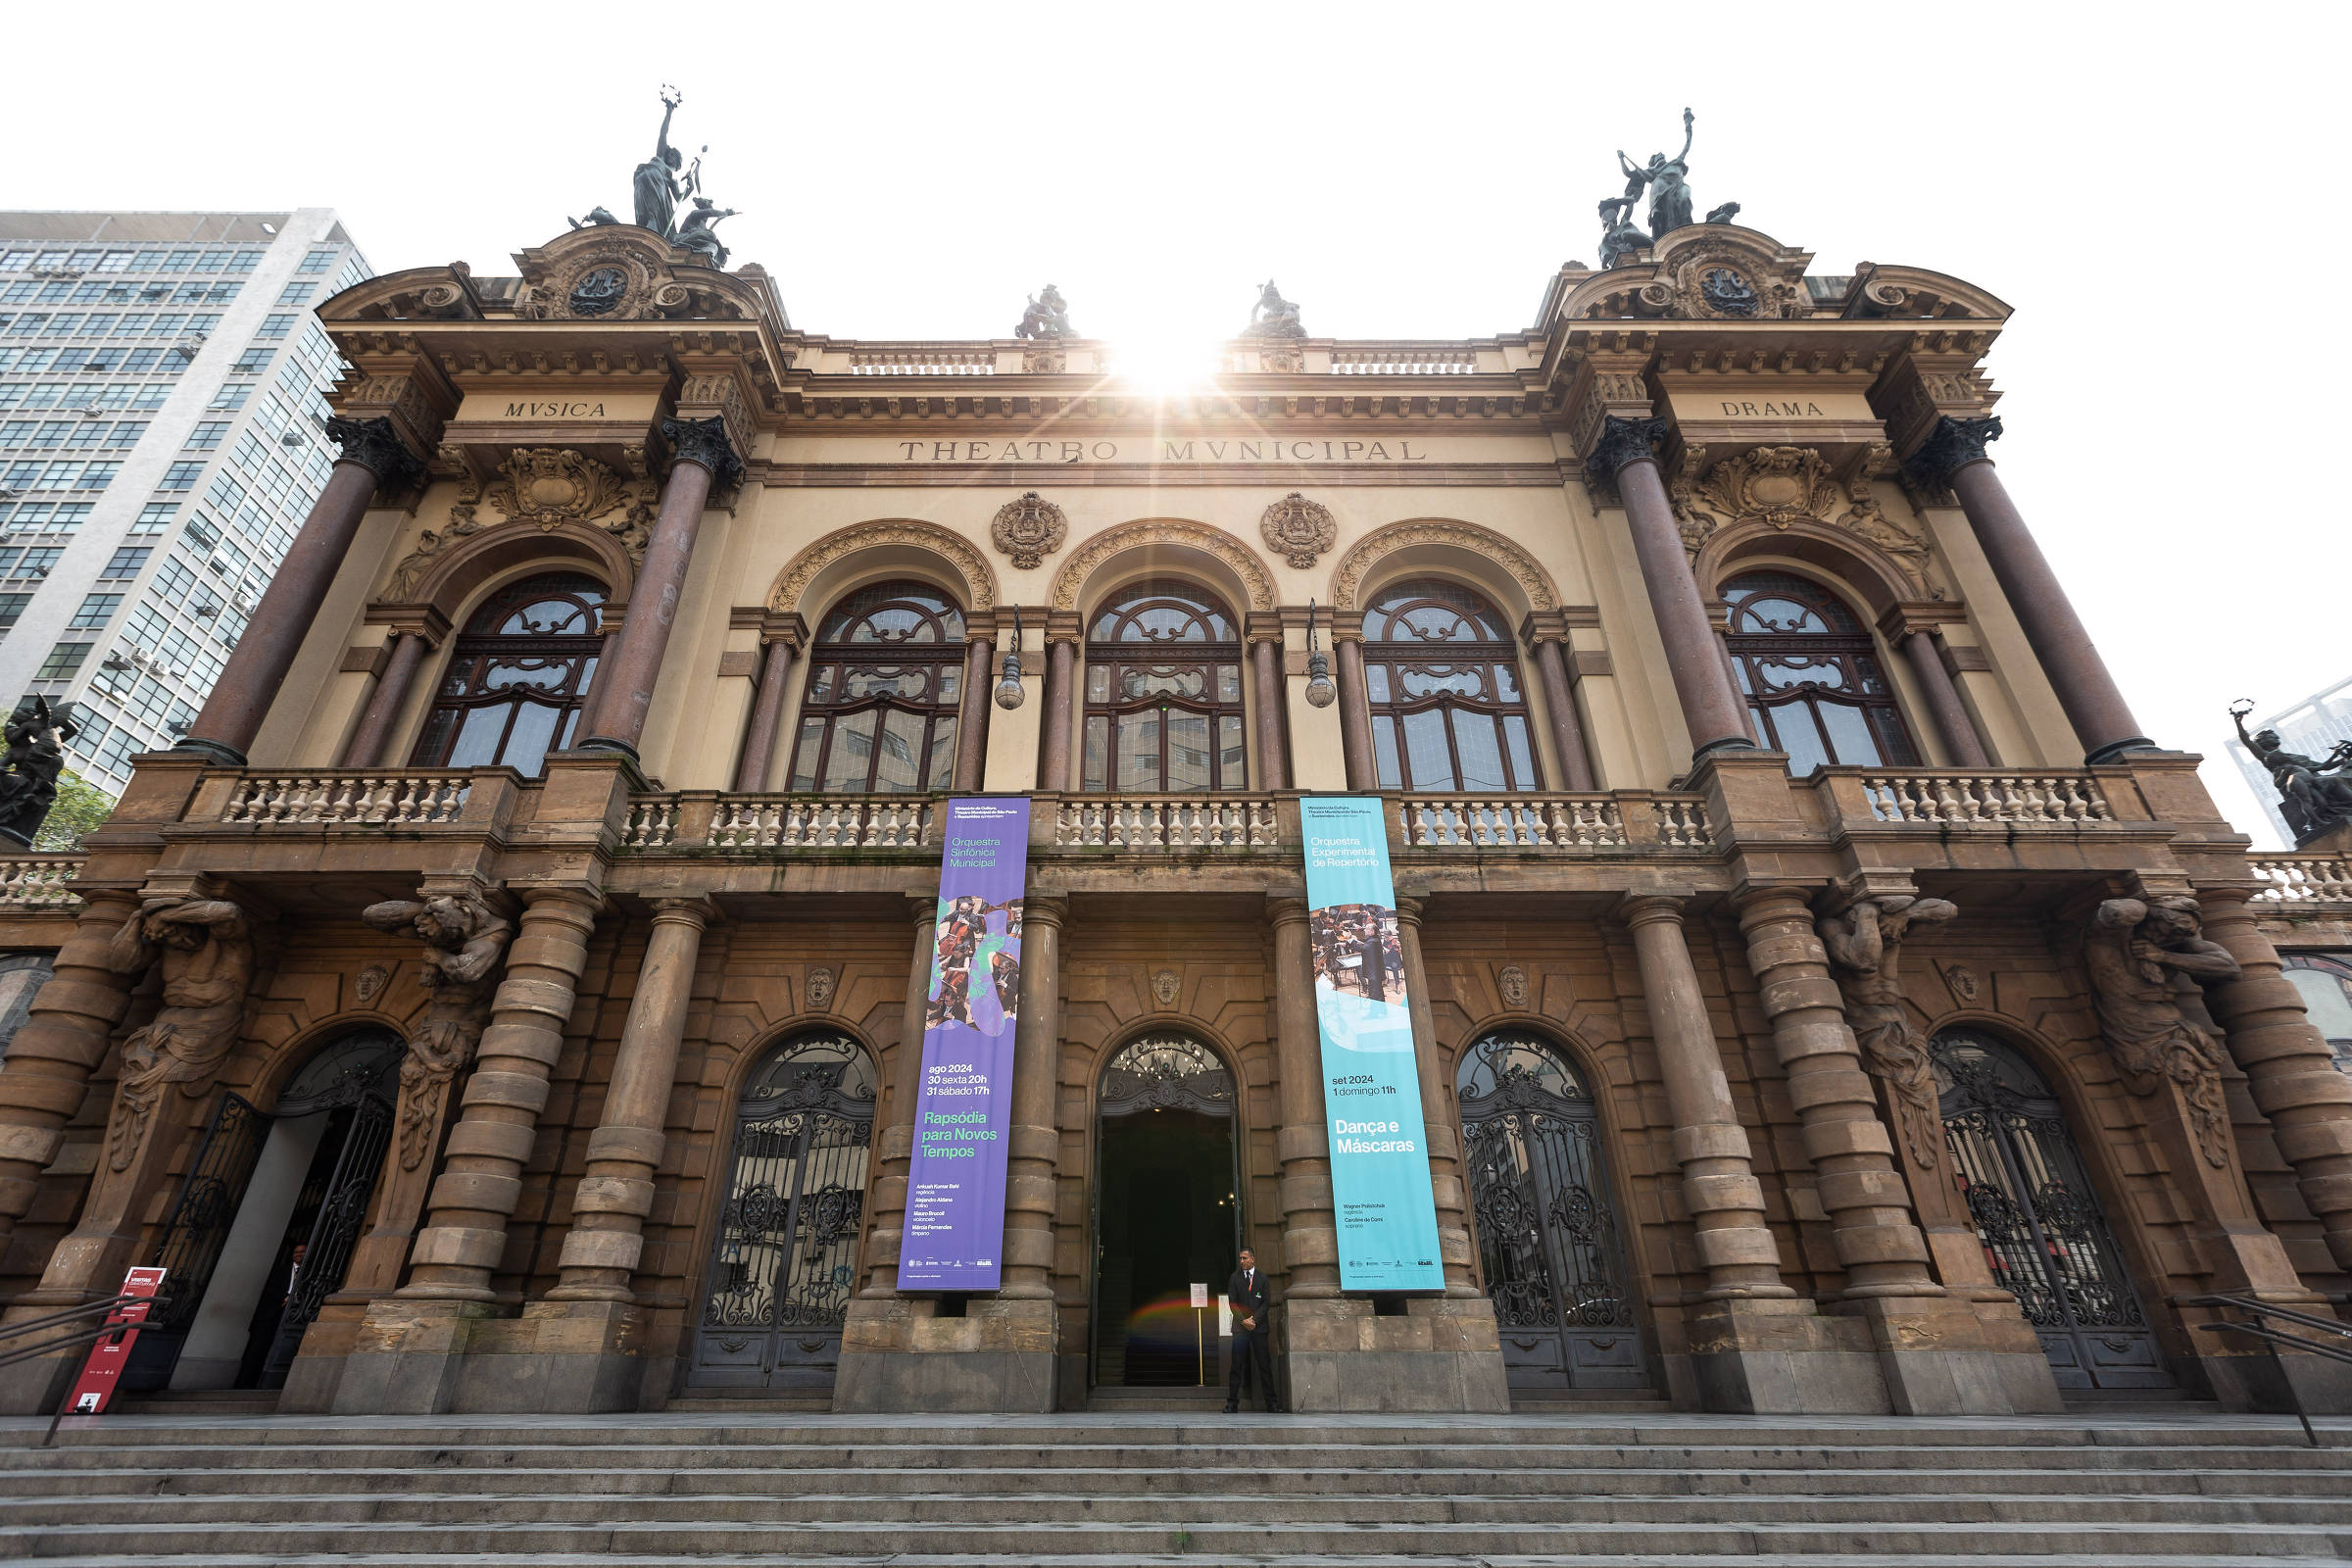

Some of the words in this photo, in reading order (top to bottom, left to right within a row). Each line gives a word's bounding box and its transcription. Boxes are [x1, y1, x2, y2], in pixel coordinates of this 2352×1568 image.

[505, 403, 605, 416] MVSICA
[1718, 402, 1824, 416] DRAMA
[899, 441, 1118, 461] THEATRO
[1164, 441, 1427, 461] MVNICIPAL
[952, 837, 1001, 847] Orquestra
[1310, 837, 1360, 847] Orquestra
[1311, 847, 1375, 857] Experimental
[950, 858, 996, 868] Municipal
[1313, 858, 1325, 867] de
[1327, 858, 1379, 867] Repertório
[948, 1064, 972, 1073] 2024
[968, 1075, 987, 1084] 20h
[1348, 1075, 1374, 1084] 2024
[927, 1087, 937, 1096] 31
[938, 1087, 972, 1096] sábado
[974, 1086, 989, 1095] 17h
[1340, 1087, 1380, 1096] domingo
[924, 1110, 987, 1126] Rapsódia
[1335, 1119, 1387, 1137] Dança
[1390, 1121, 1399, 1133] e
[921, 1131, 952, 1144] para
[955, 1128, 997, 1141] Novos
[1337, 1139, 1415, 1153] Máscaras
[921, 1145, 974, 1160] Tempos
